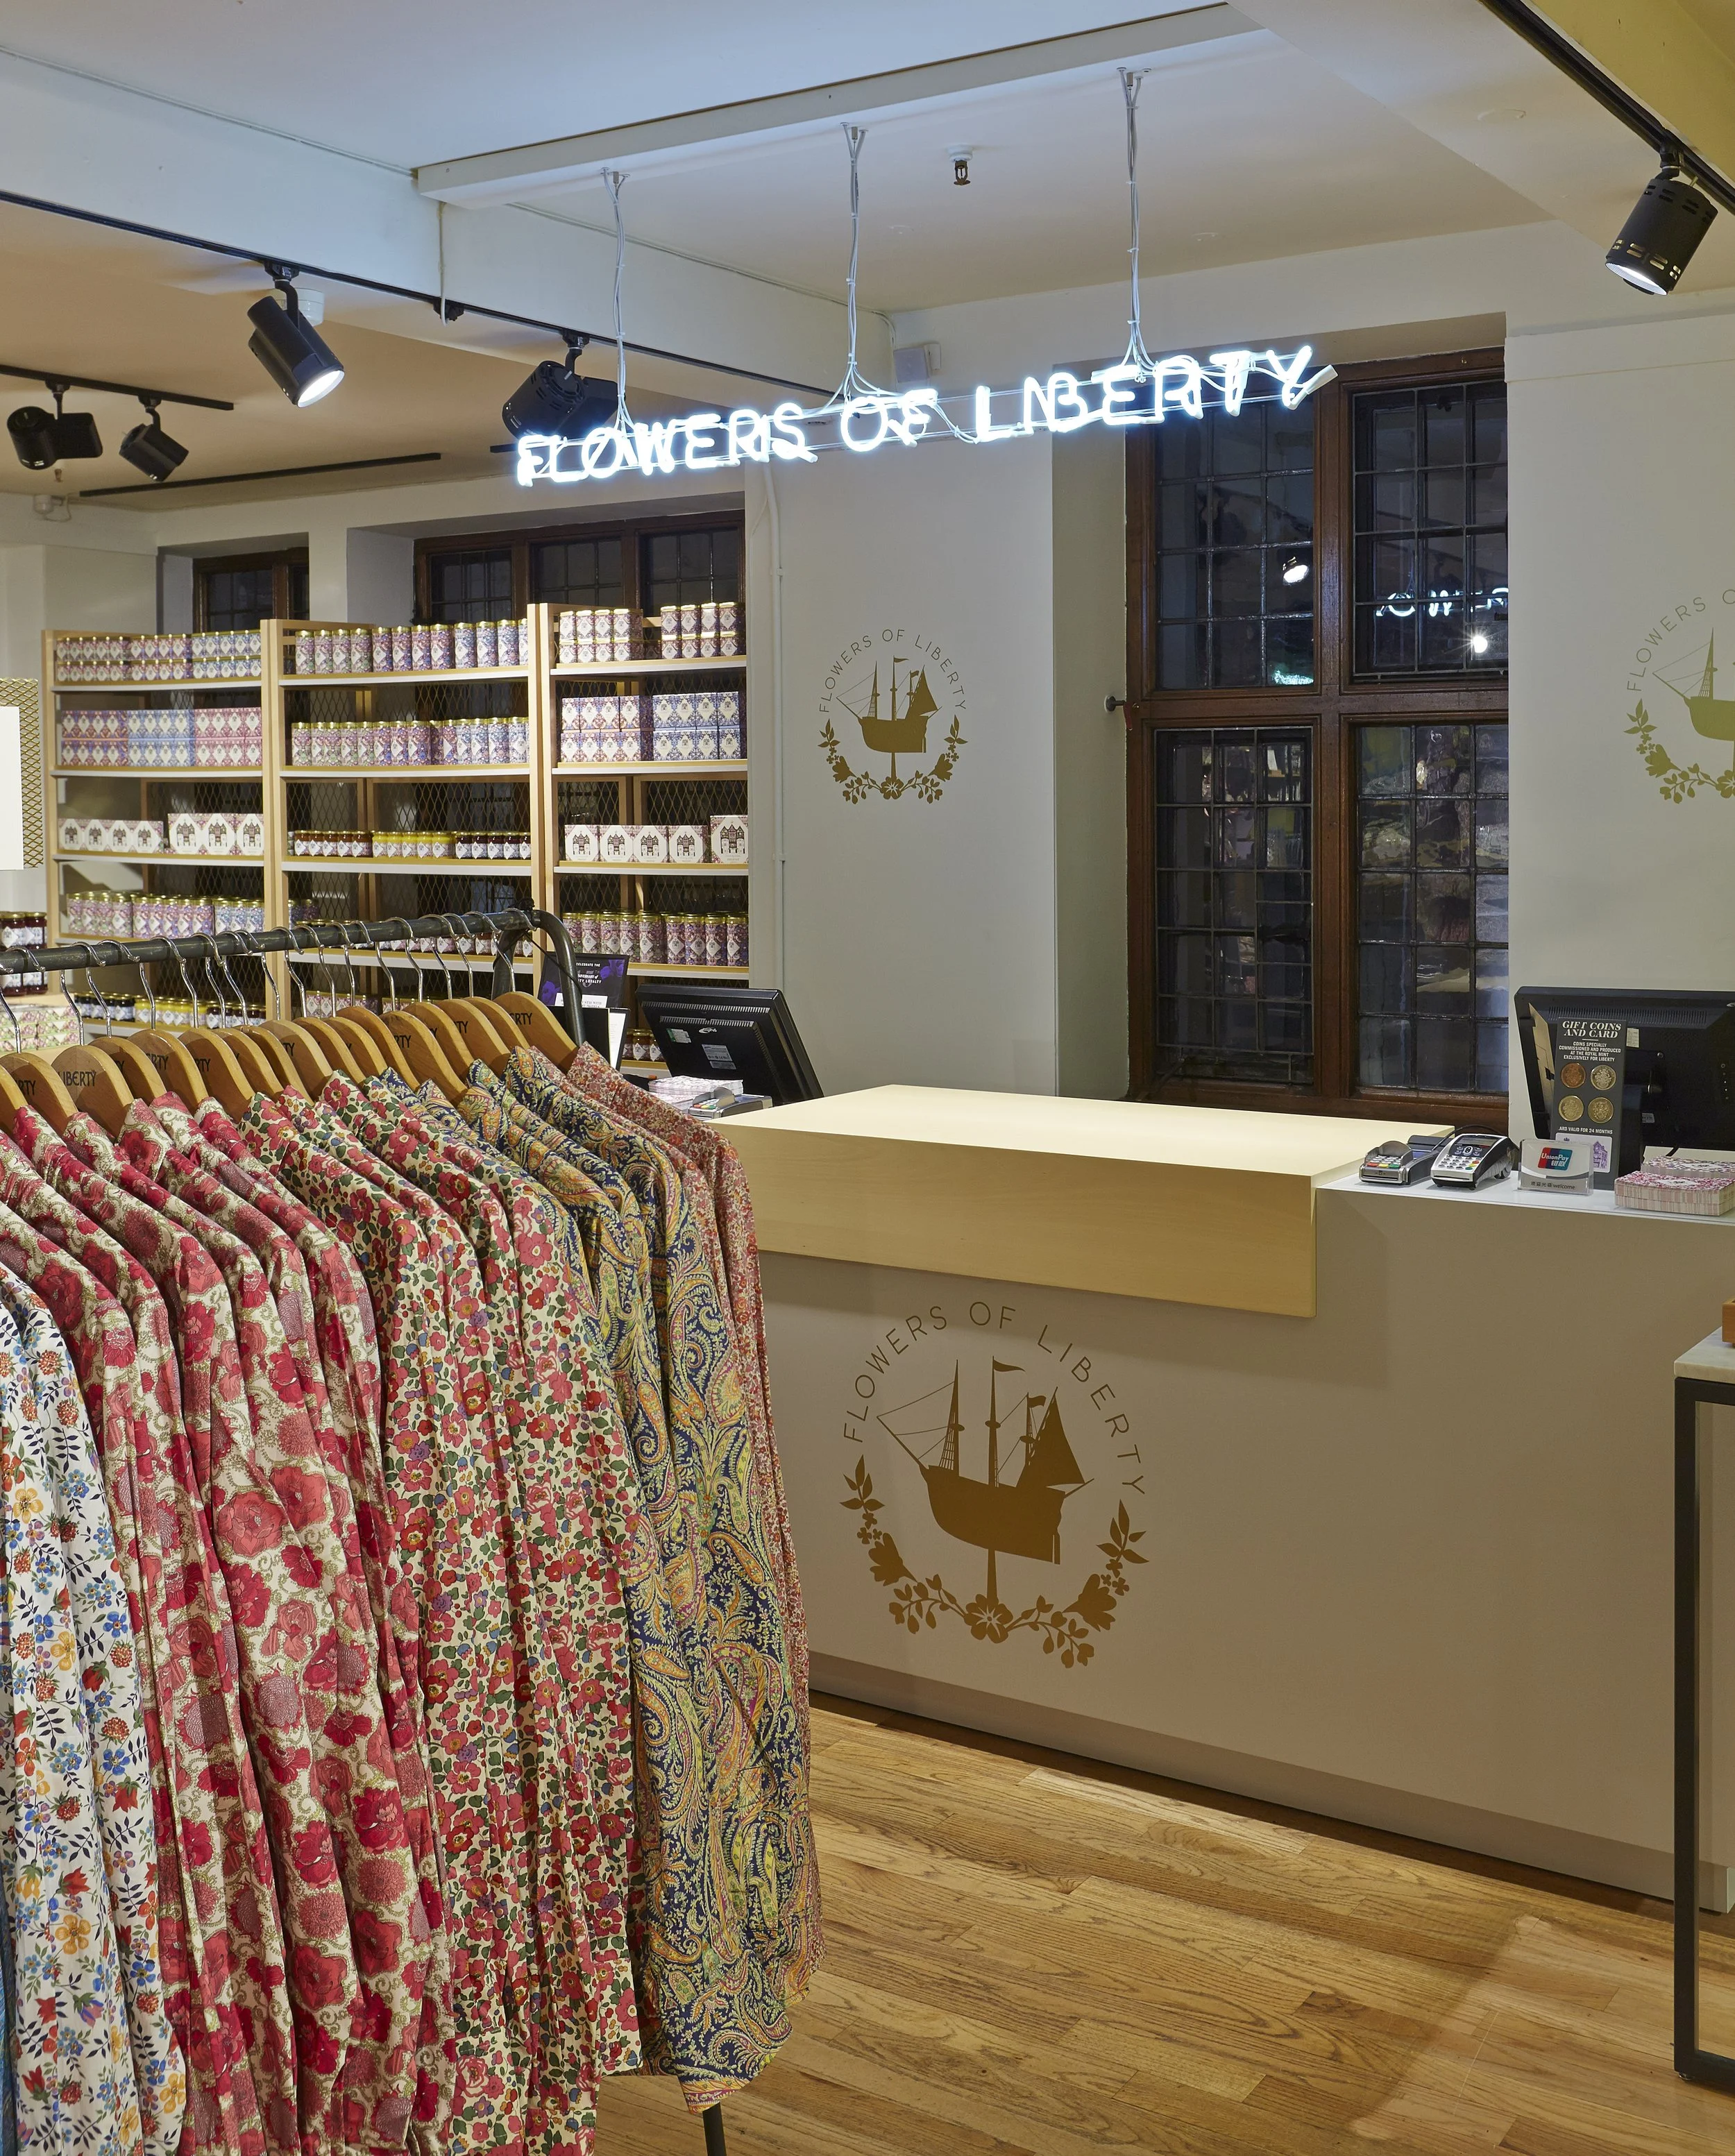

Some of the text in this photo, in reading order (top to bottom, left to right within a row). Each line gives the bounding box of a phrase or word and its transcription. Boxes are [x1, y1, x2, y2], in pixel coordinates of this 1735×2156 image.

[517, 402, 815, 487] FLOWERS
[841, 389, 938, 452] OF
[820, 629, 967, 713] FLOWERS OF LIBERTY
[1627, 589, 1735, 691] FLOWERS O
[1562, 1021, 1621, 1030] GIFT COINS
[1589, 1030, 1618, 1038] CARD
[1541, 1153, 1569, 1163] UnionPay
[843, 1301, 1145, 1495] FLOWERS OF LIBERTY
